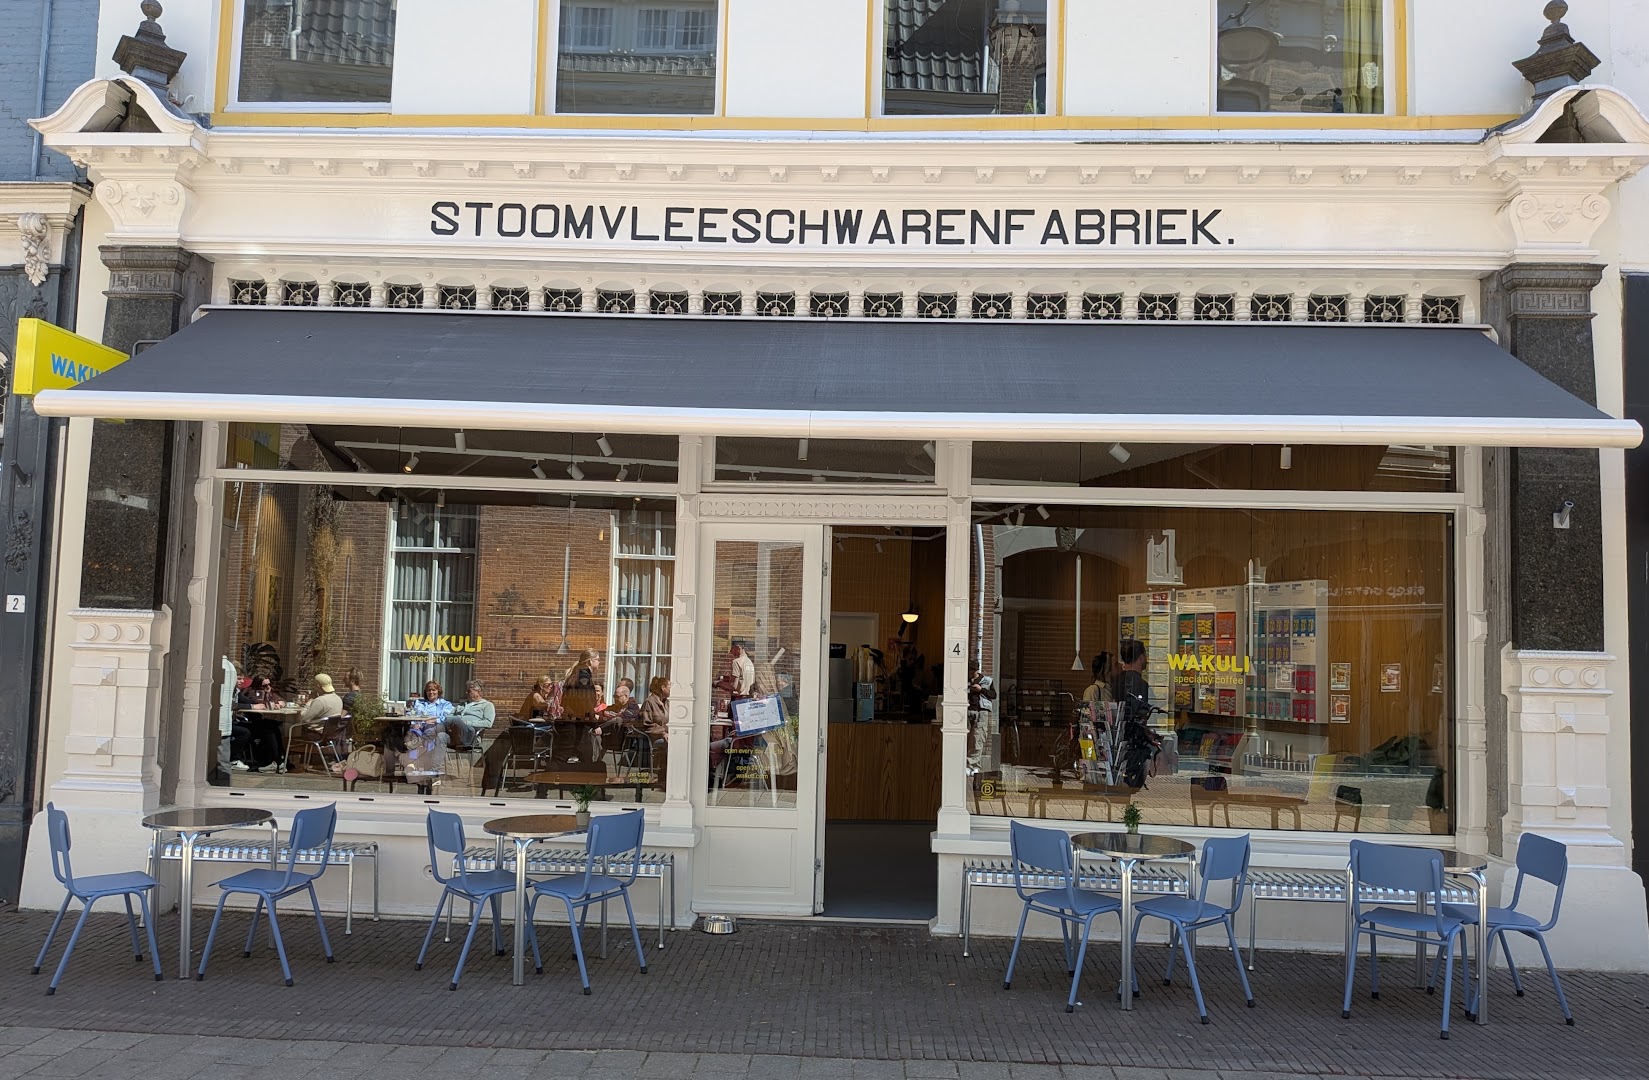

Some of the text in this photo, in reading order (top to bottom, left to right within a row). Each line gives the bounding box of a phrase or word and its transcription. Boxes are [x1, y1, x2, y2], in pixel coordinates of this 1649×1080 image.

[430, 201, 1234, 245] STOOMVLEESCHWARENFABRIEK.
[13, 597, 18, 610] 2
[404, 633, 482, 653] WAKULI
[953, 642, 961, 656] 4
[409, 655, 475, 664] specalty coffee
[1167, 653, 1250, 673] WAKULI
[1173, 675, 1243, 685] specialty coffee
